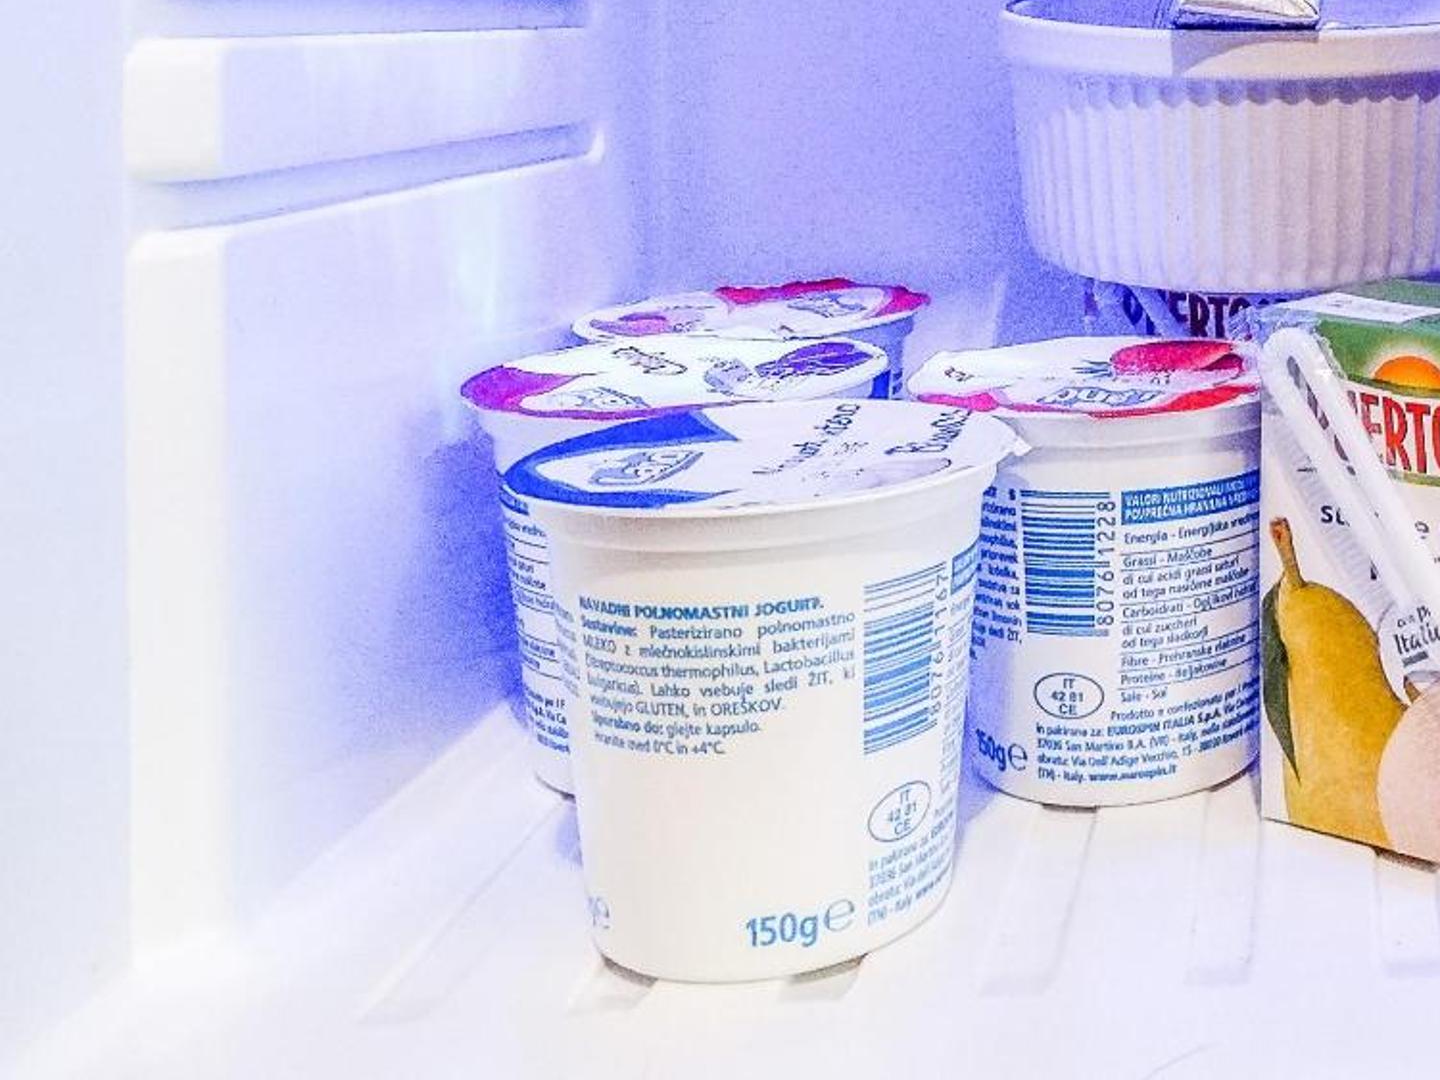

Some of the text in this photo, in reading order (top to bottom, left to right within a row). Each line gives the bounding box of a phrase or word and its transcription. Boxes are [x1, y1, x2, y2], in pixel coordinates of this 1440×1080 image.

[1124, 531, 1168, 545] Energia
[1096, 501, 1116, 626] 80761228
[1123, 555, 1157, 568] Grassi
[634, 604, 749, 619] POLNOMASTNI
[650, 624, 742, 639] Pasterizirano
[757, 611, 856, 639] polnomastno
[773, 628, 855, 653] bakterijami
[661, 661, 759, 678] thermophilus,
[764, 649, 855, 674] Lactobacillus
[651, 684, 690, 697] Lahko
[700, 683, 753, 702] vsebuje
[764, 675, 797, 693] sledi
[1063, 678, 1076, 689] IT
[1051, 691, 1066, 702] 42
[635, 700, 689, 718] GLUTEN,
[1059, 704, 1077, 715] CE
[644, 720, 663, 734] do:
[746, 912, 818, 947] 150g
